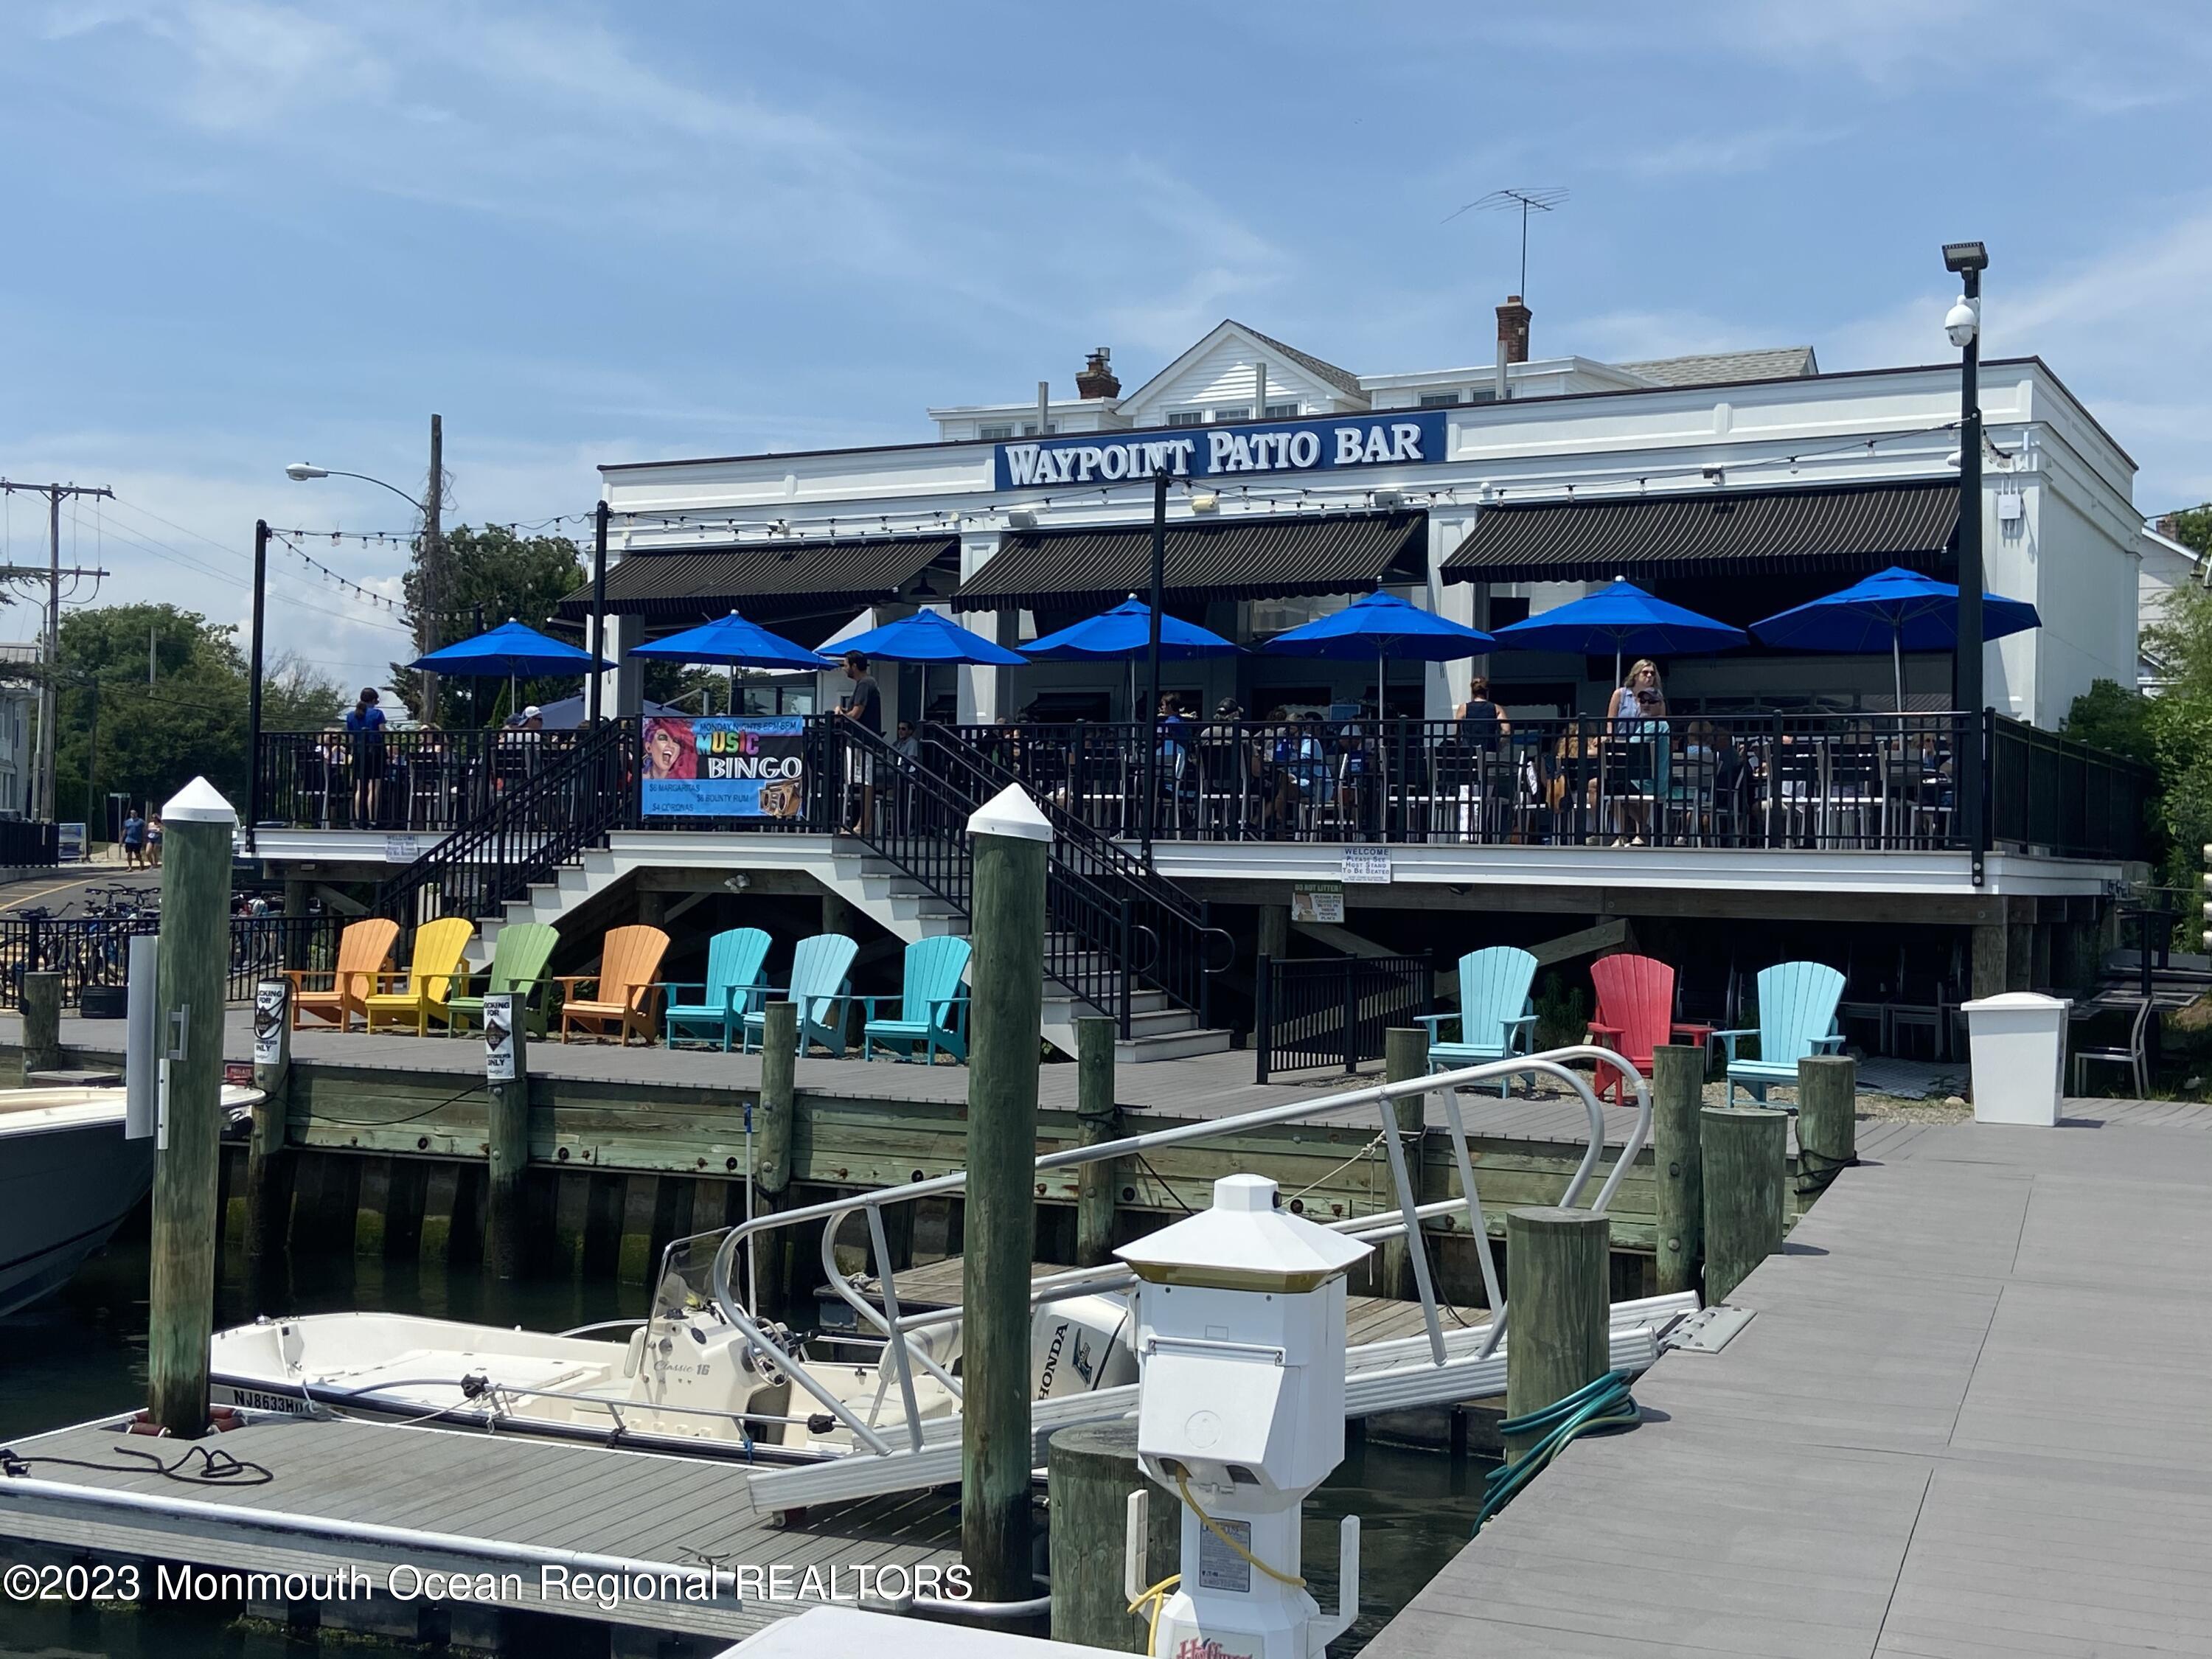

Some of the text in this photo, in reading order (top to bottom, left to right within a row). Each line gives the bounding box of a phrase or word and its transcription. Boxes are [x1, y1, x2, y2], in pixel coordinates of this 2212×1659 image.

[1005, 422, 1424, 485] WAYPOINT PATIO BAR
[700, 723, 731, 731] MONDAY
[695, 731, 759, 755] MUSIC
[708, 757, 802, 779] BINGO
[658, 784, 700, 793] MARGARITAS
[654, 1360, 710, 1375] Classic 16
[1038, 1323, 1069, 1400] HONDA
